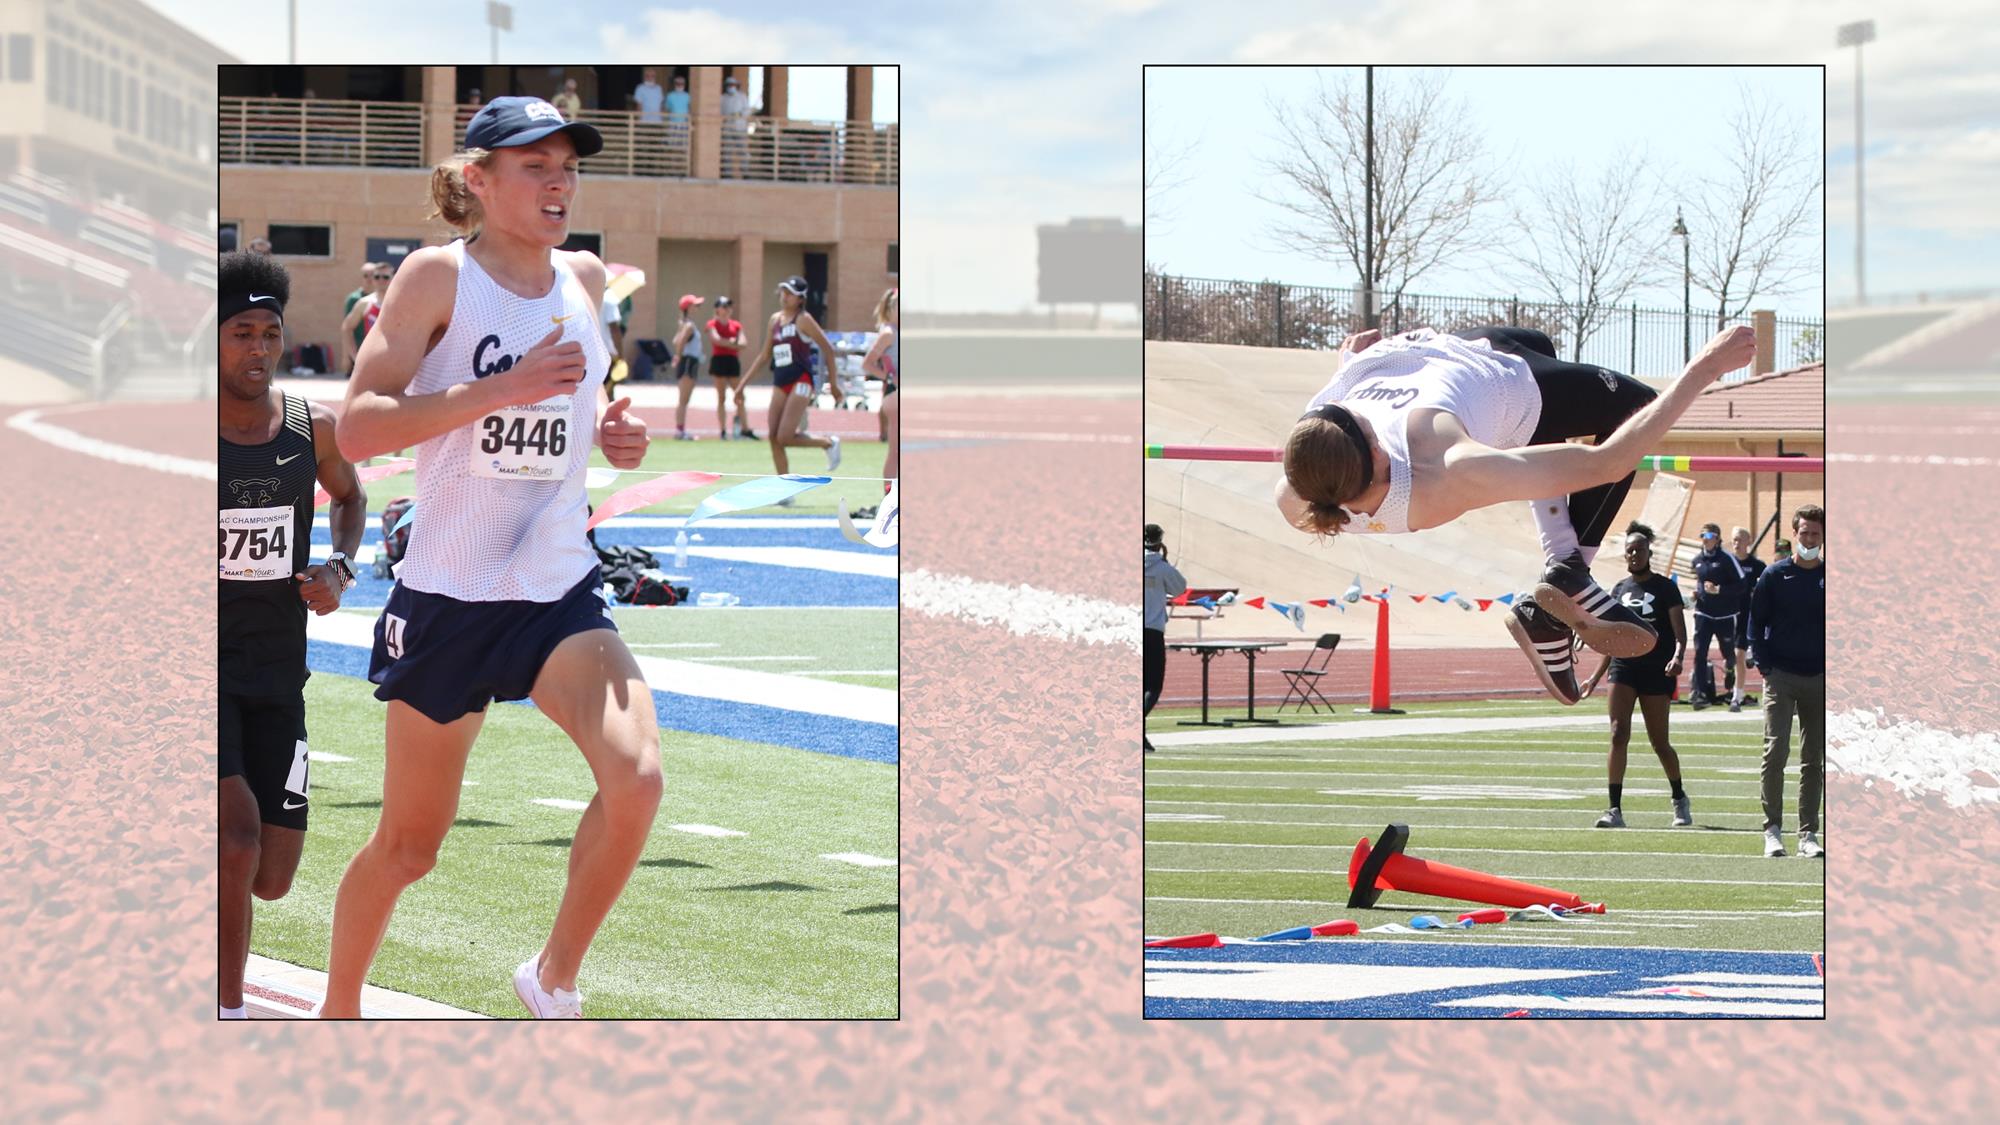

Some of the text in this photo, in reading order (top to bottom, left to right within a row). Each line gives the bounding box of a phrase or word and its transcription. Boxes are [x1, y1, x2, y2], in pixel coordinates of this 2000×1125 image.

[511, 404, 570, 413] CHAMPIONSHIP
[481, 415, 567, 457] 3446
[498, 467, 519, 475] MAKE
[232, 513, 290, 524] CHAMPIONSHIP
[254, 567, 276, 578] YOURS
[387, 619, 399, 657] 4
